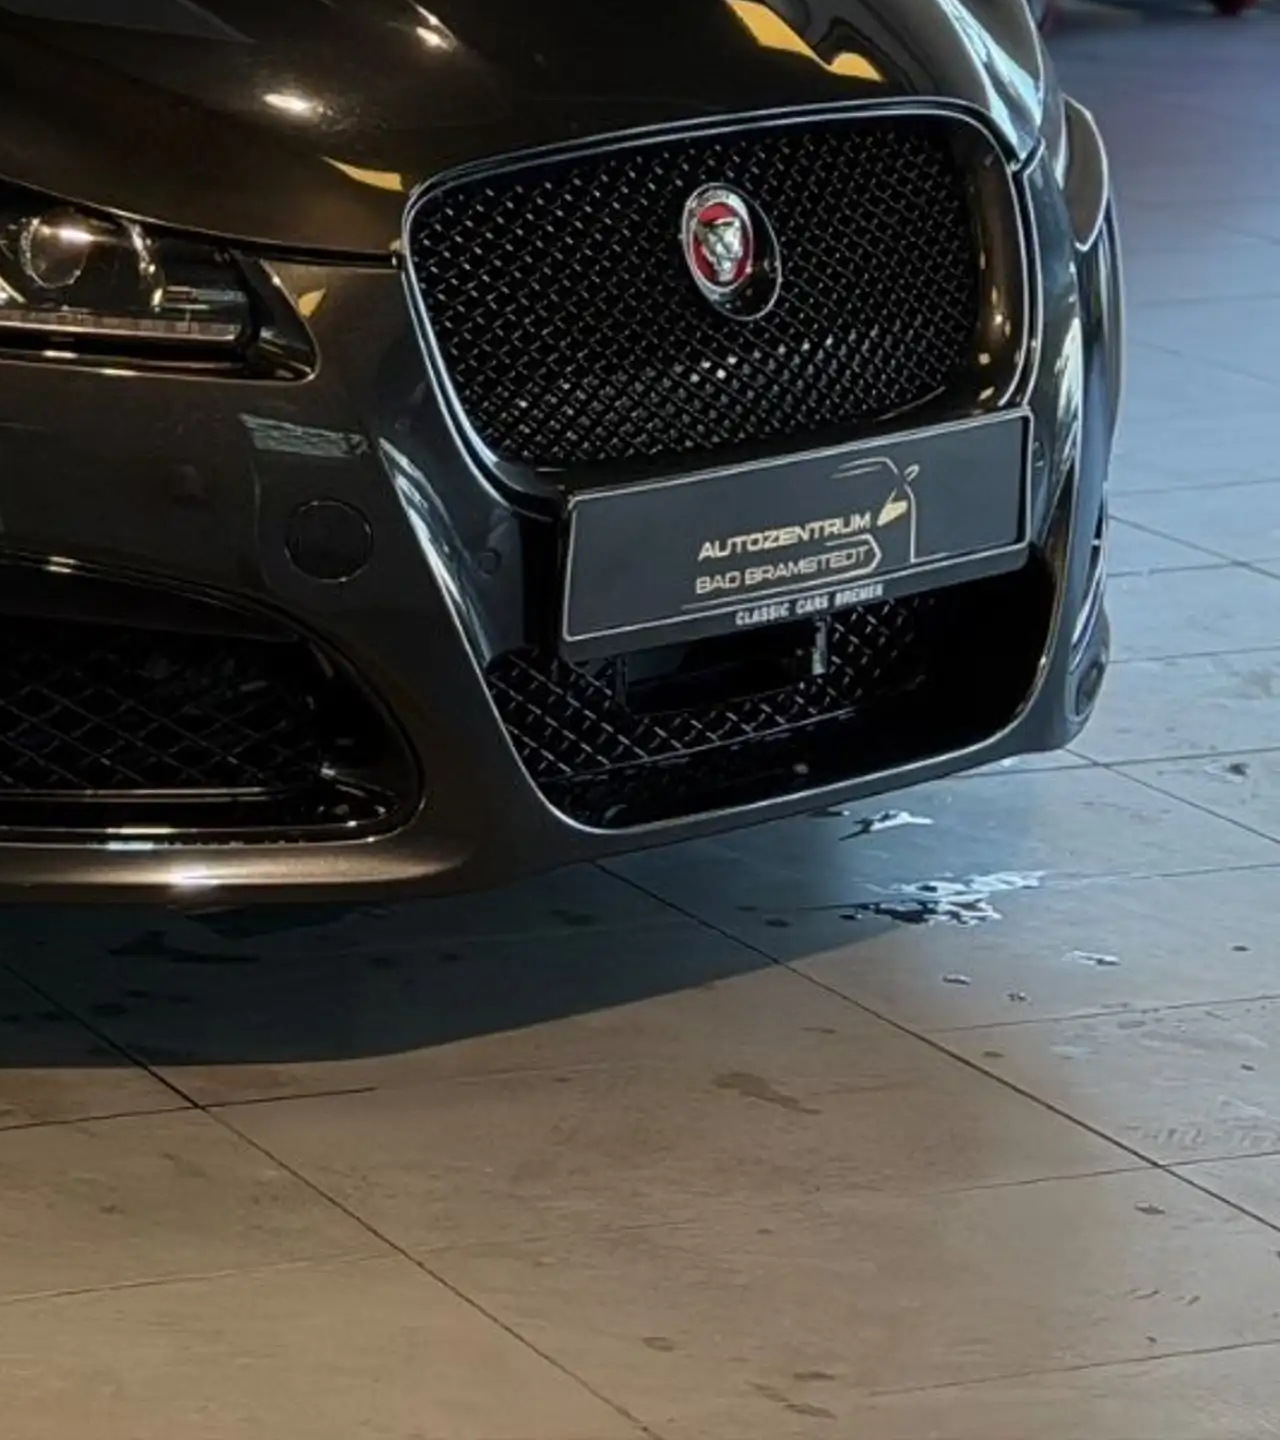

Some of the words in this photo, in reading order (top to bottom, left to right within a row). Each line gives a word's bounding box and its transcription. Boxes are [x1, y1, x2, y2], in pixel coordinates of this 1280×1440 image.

[697, 511, 872, 561] AUTOZENTRUM
[695, 572, 740, 595] BAD
[744, 544, 872, 585] BRAMSTEDT
[734, 601, 791, 626] CLASSIC
[794, 594, 830, 615] CARS
